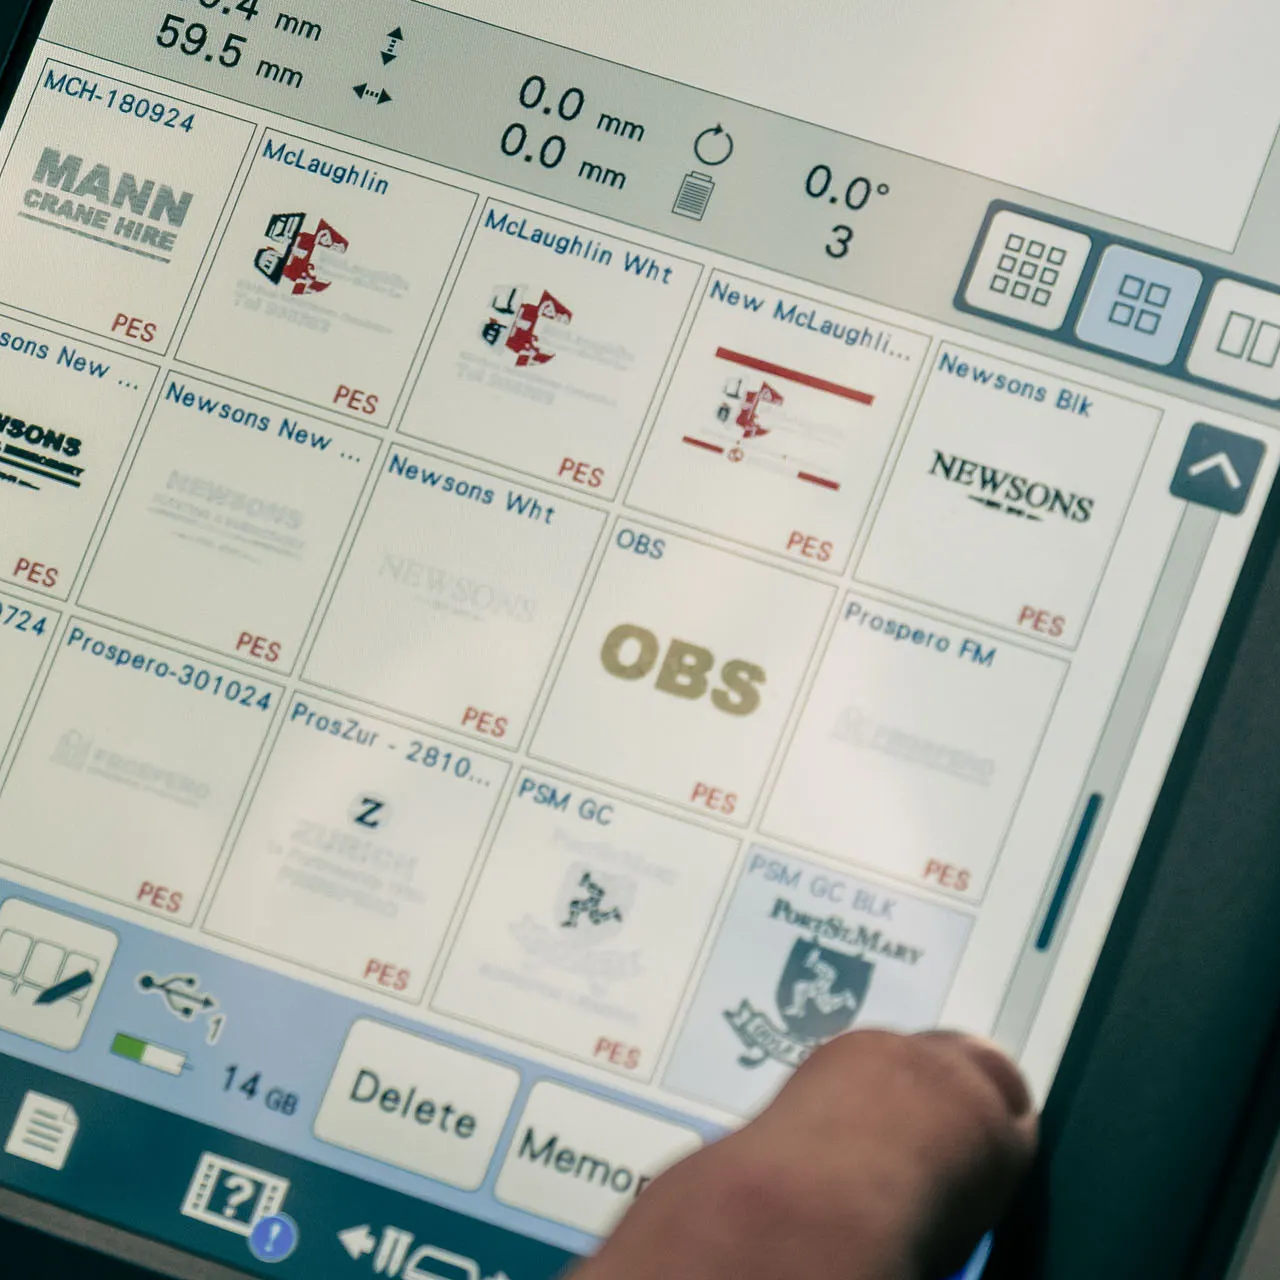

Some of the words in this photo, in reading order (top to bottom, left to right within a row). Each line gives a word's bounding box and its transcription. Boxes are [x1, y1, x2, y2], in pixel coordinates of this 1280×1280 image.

[275, 12, 322, 41] mm
[156, 13, 247, 68] 59.5
[256, 60, 303, 89] mm
[43, 70, 196, 132] MCH-180924
[519, 75, 584, 121] 0.0
[597, 113, 645, 141] mm
[262, 139, 389, 195] McLaughlin
[500, 122, 566, 168] 0.0
[578, 160, 626, 190] mm
[32, 146, 194, 227] MANN
[23, 188, 110, 230] CRANE
[114, 216, 178, 252] HIRE
[825, 224, 854, 258] 3
[484, 209, 612, 265] McLaughlin
[624, 252, 673, 284] Wht
[710, 280, 765, 312] New
[111, 312, 157, 342] PES
[56, 346, 110, 378] New
[938, 352, 1048, 402] Newsons
[166, 382, 270, 432] Newsons
[278, 418, 332, 450] New
[332, 384, 379, 414] PES
[388, 454, 495, 504] Newsons
[506, 491, 556, 524] Wht
[558, 457, 604, 488] PES
[929, 449, 1094, 523] NEWSONS
[616, 529, 666, 560] OBS
[786, 530, 833, 562] PES
[12, 557, 59, 588] PES
[845, 602, 950, 652] Prospero
[958, 638, 997, 668] FM
[1018, 605, 1066, 638] PES
[67, 627, 272, 711] Prospero-301024
[235, 632, 281, 662] PES
[600, 624, 766, 716] OBS
[291, 702, 379, 748] ProsZur
[461, 706, 508, 738] PES
[353, 798, 384, 829] Z
[519, 778, 572, 813] PSM
[579, 799, 615, 826] GC
[690, 782, 738, 814] PES
[137, 881, 183, 913] PES
[749, 854, 802, 889] PSM
[809, 875, 844, 902] GC
[923, 858, 971, 891] PES
[363, 958, 410, 991] PES
[593, 1036, 641, 1070] PES
[222, 1064, 262, 1100] 14
[265, 1087, 299, 1116] GB
[350, 1069, 477, 1138] Delete
[520, 1127, 651, 1199] Memor
